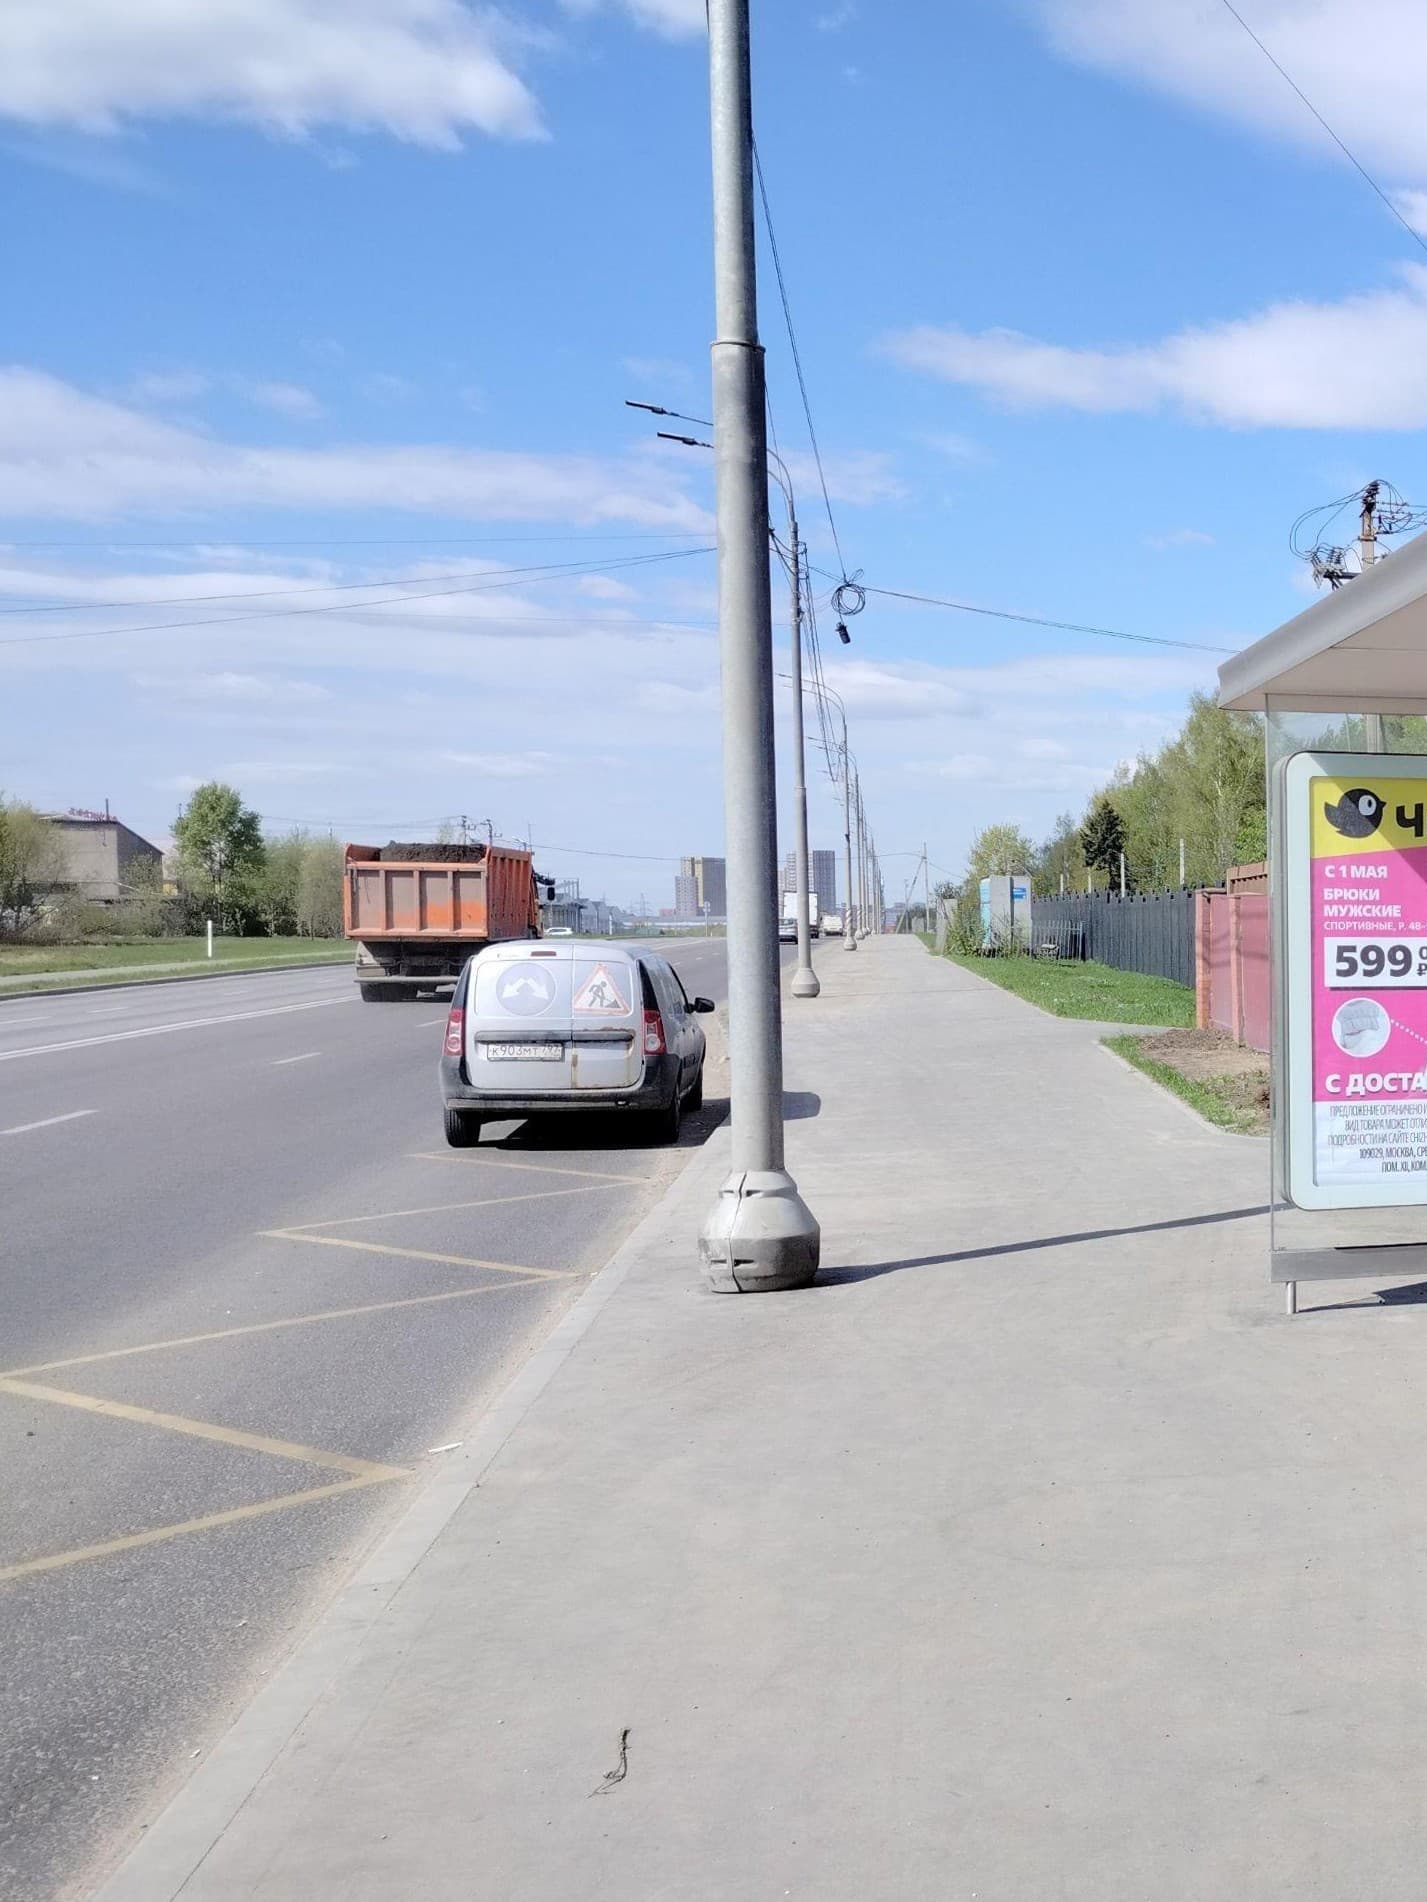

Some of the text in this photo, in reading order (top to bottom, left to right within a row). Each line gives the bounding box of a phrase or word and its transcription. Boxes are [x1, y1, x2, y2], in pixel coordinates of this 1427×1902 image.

[1325, 865, 1388, 878] С 1 МАЯ
[1323, 888, 1380, 900] БРЮКИ
[1323, 905, 1402, 917] МУЖСКИЕ
[1324, 921, 1397, 932] СПОРТИВНЫЕ,
[1399, 922, 1407, 931] Р.
[1336, 944, 1413, 978] 599
[1325, 1074, 1341, 1093] С
[1330, 1104, 1380, 1118] ПРЕДЛОЖЕНИЕ
[1381, 1104, 1422, 1116] ОГРАНИЧЕНО
[1345, 1120, 1359, 1132] ВИД
[1360, 1119, 1384, 1130] ТОВАРА
[1385, 1146, 1416, 1158] МОСКВА,
